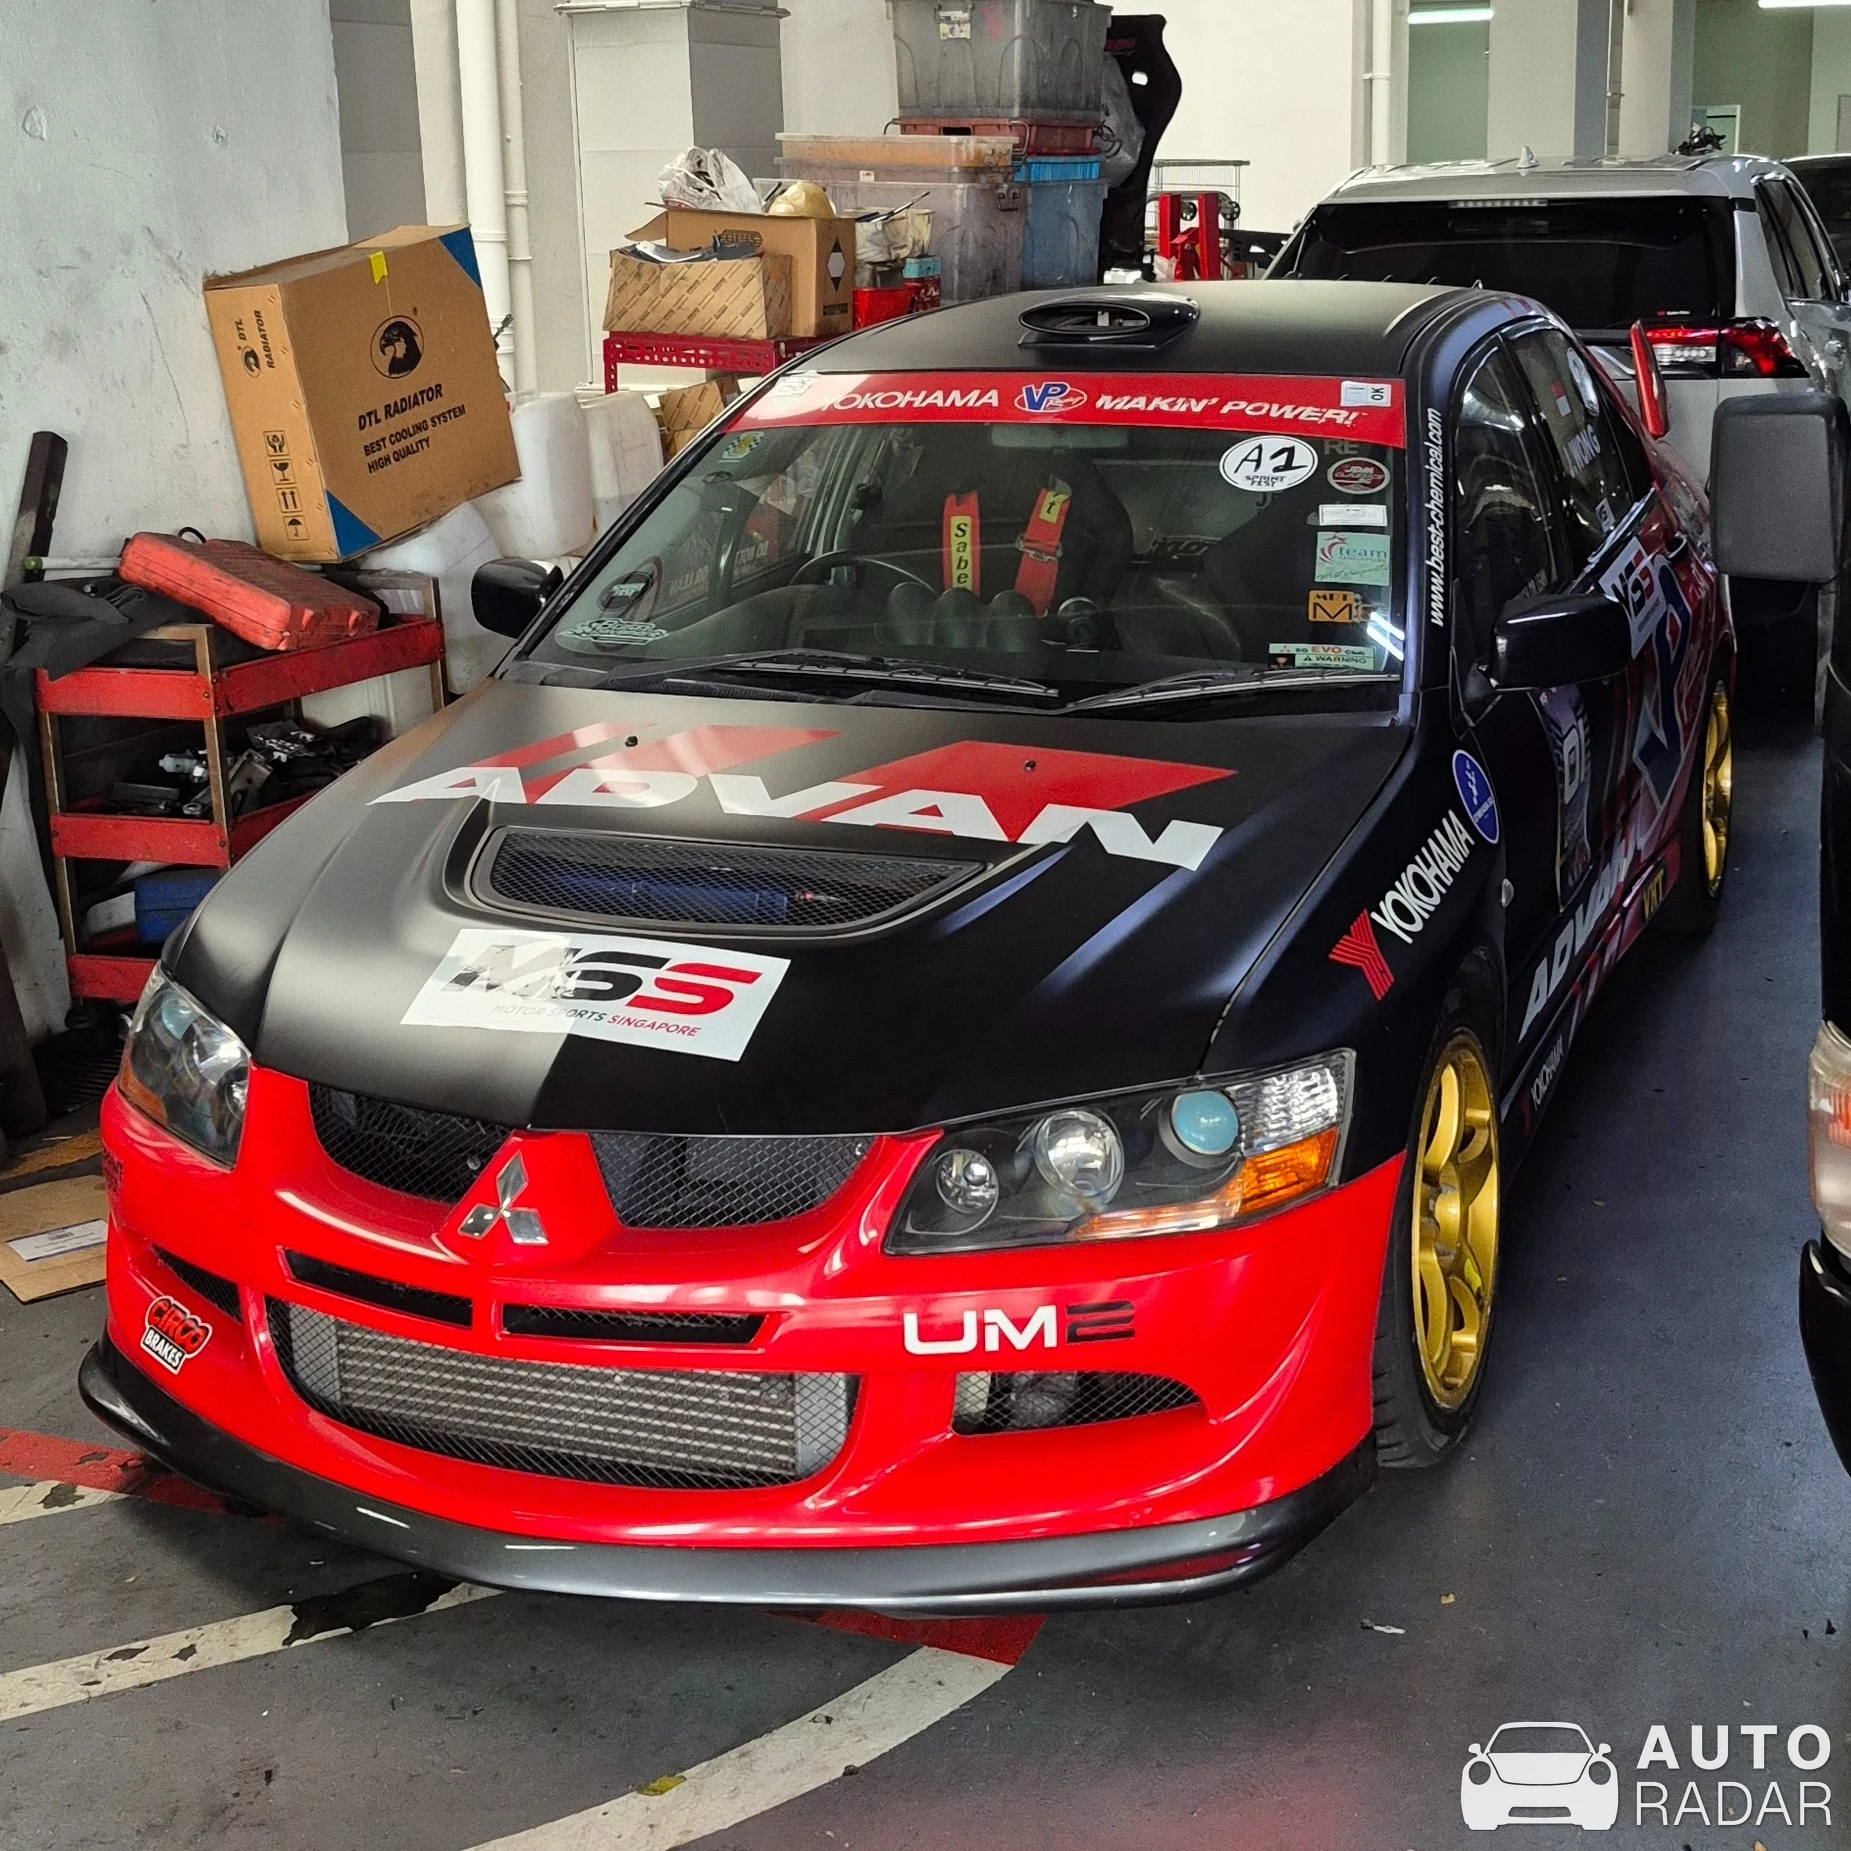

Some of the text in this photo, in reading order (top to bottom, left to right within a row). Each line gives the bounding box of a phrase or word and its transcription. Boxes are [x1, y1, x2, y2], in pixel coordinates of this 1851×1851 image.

[235, 318, 246, 341] DTL
[254, 310, 275, 369] RADIATOR
[358, 383, 443, 431] DTL RADIATOR
[821, 388, 1000, 412] YOKOHAMA
[1371, 386, 1384, 401] OK
[363, 404, 466, 457] BEST COOLING SYSTEM
[367, 436, 431, 474] HIGH QUALITY
[1233, 443, 1309, 474] A1
[1424, 407, 1445, 628] www.best-chemical.com
[1339, 547, 1387, 559] team
[1310, 645, 1342, 654] EVO
[1315, 655, 1367, 664] WARNING
[366, 766, 1224, 872] ADVAN
[1370, 808, 1476, 945] YOKOHAMA
[549, 1006, 607, 1022] SPORTS
[607, 1014, 701, 1037] SINGAPORE
[143, 1328, 183, 1368] BRAKES
